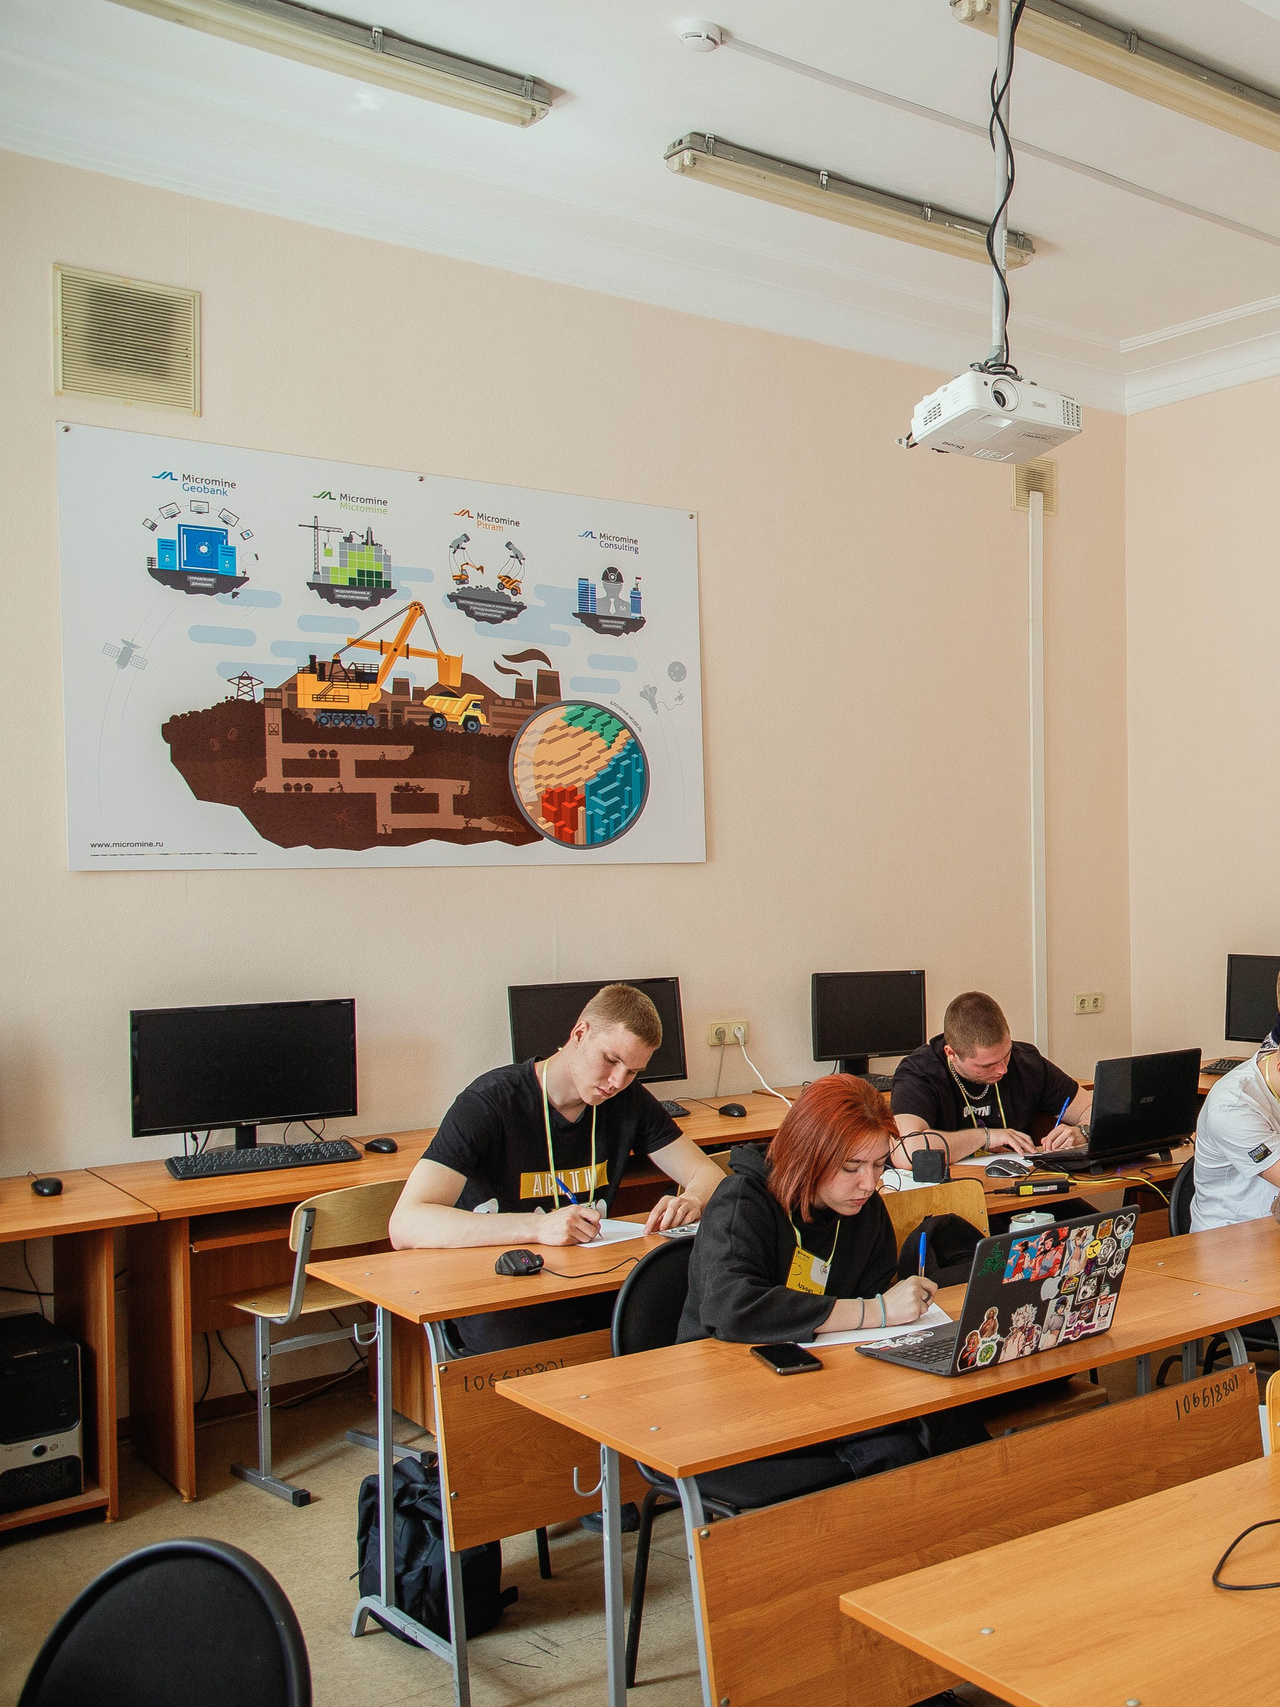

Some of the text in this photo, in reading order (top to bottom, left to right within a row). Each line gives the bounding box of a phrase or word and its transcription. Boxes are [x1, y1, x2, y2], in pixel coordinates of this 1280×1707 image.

[182, 474, 236, 489] Micromine
[182, 482, 228, 496] Geobank
[340, 493, 388, 506] Micromine
[340, 502, 388, 514] Micromine
[476, 512, 520, 527] Micromine
[476, 520, 504, 532] Pitram
[600, 532, 638, 545] Micromine
[600, 540, 640, 554] Consulting
[1176, 1374, 1238, 1420] 106618801
